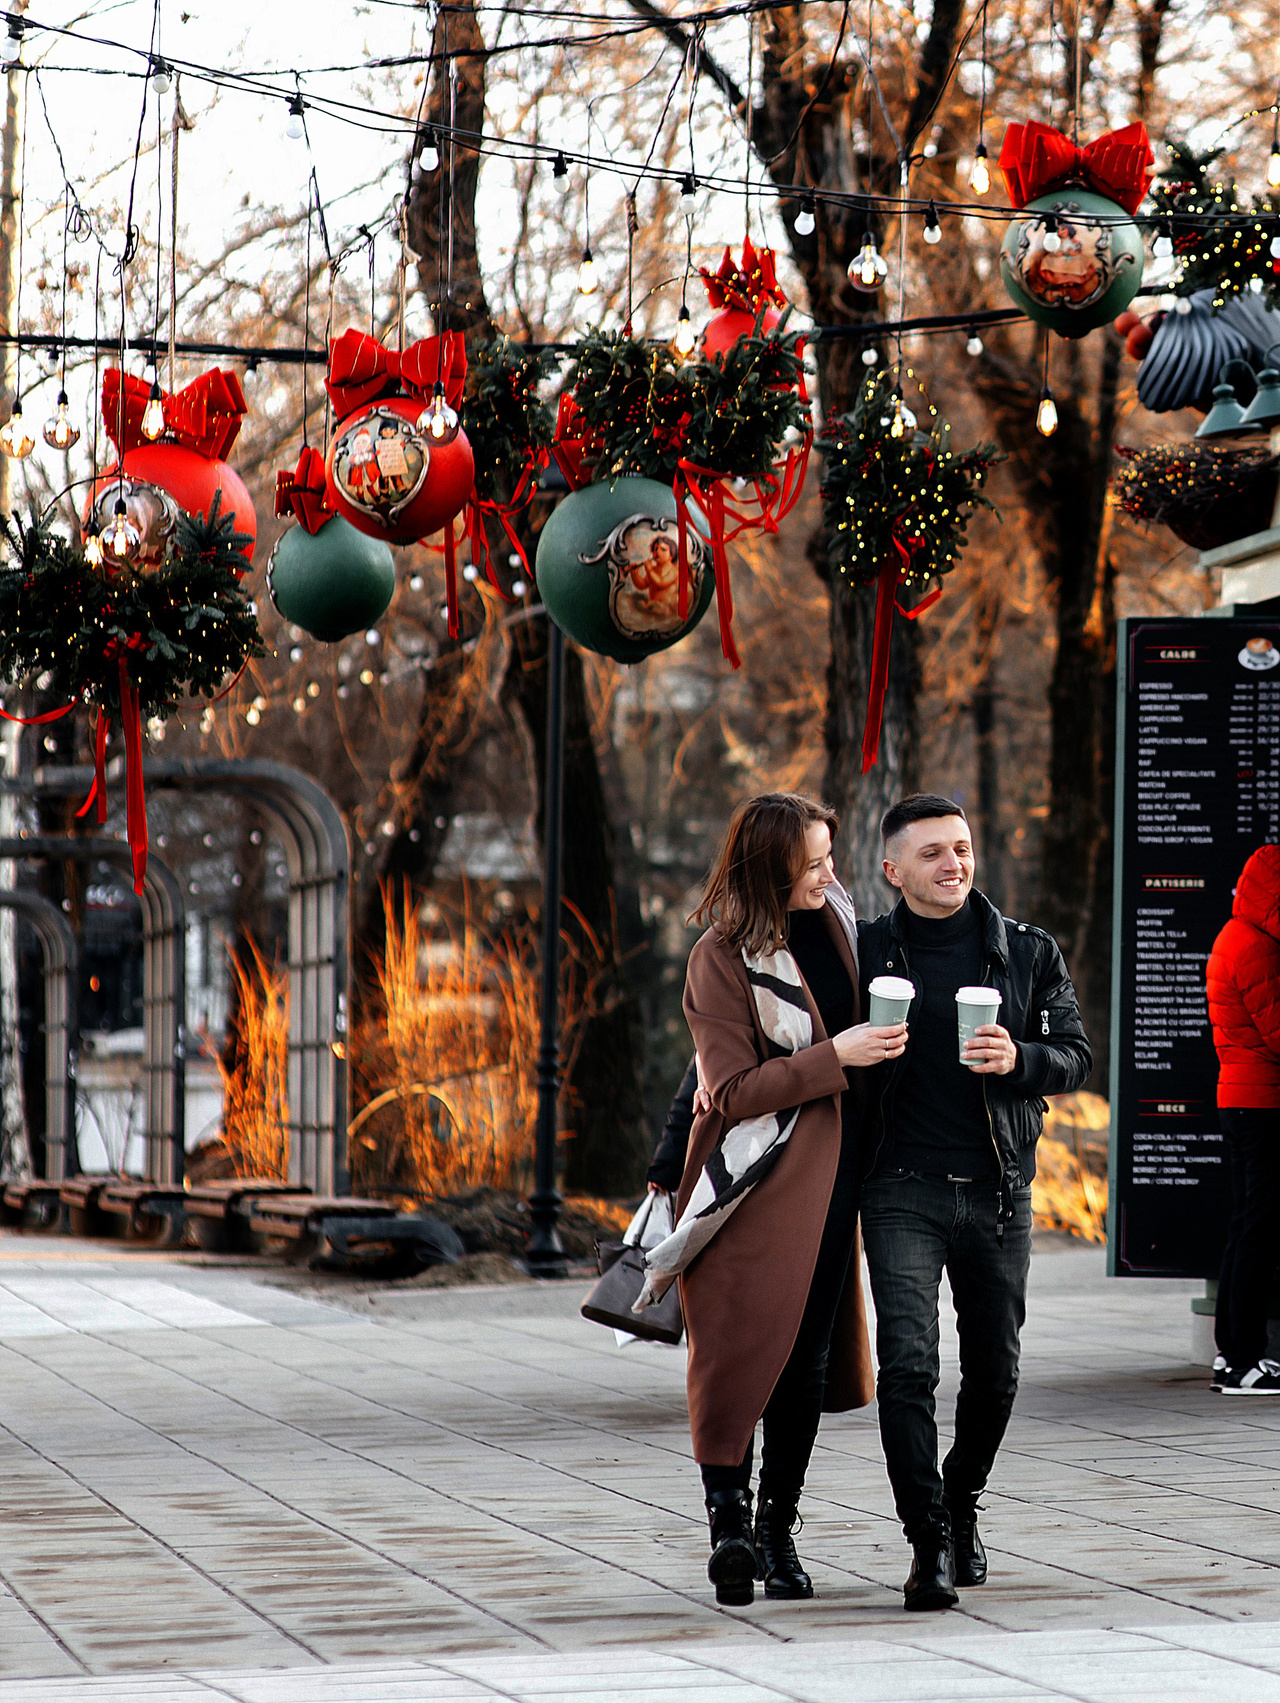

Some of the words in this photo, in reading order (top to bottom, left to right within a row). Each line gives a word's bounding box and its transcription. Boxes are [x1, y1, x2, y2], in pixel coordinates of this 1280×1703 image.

[1160, 650, 1197, 659] CALDE
[1138, 682, 1172, 690] ESPRESSO
[1138, 693, 1169, 701] ESPRESSO
[1139, 704, 1179, 712] AMERICANO
[1138, 715, 1183, 723] CAPPUCCINO
[1138, 726, 1159, 734] LATTE
[1138, 737, 1182, 745] CAPPUCCINO
[1184, 737, 1207, 745] VEGAN
[1138, 770, 1160, 778] CAFEA
[1162, 770, 1170, 778] DE
[1138, 781, 1166, 789] MATCHA
[1138, 792, 1163, 800] BISCUIT
[1165, 792, 1190, 800] COFFEE
[1175, 803, 1201, 811] INFUZIE
[1145, 879, 1205, 888] PATISERIE
[1137, 908, 1174, 916] CROISSANT
[1137, 919, 1162, 927] MUFFIN
[1166, 930, 1187, 938] TELLA
[1137, 941, 1164, 949] BRETZEL
[1166, 941, 1176, 949] CU
[1136, 963, 1164, 971] BRETZEL
[1165, 963, 1175, 971] CU
[1136, 974, 1164, 982] BRETZEL
[1165, 974, 1175, 982] CU
[1136, 985, 1172, 993] CROISSANT
[1174, 985, 1184, 993] CU
[1168, 1007, 1178, 1015] CU
[1168, 1018, 1178, 1026] CU
[1168, 1029, 1178, 1037] CU
[1158, 1104, 1186, 1113] RECE
[1133, 1133, 1171, 1141] COCA-COLA
